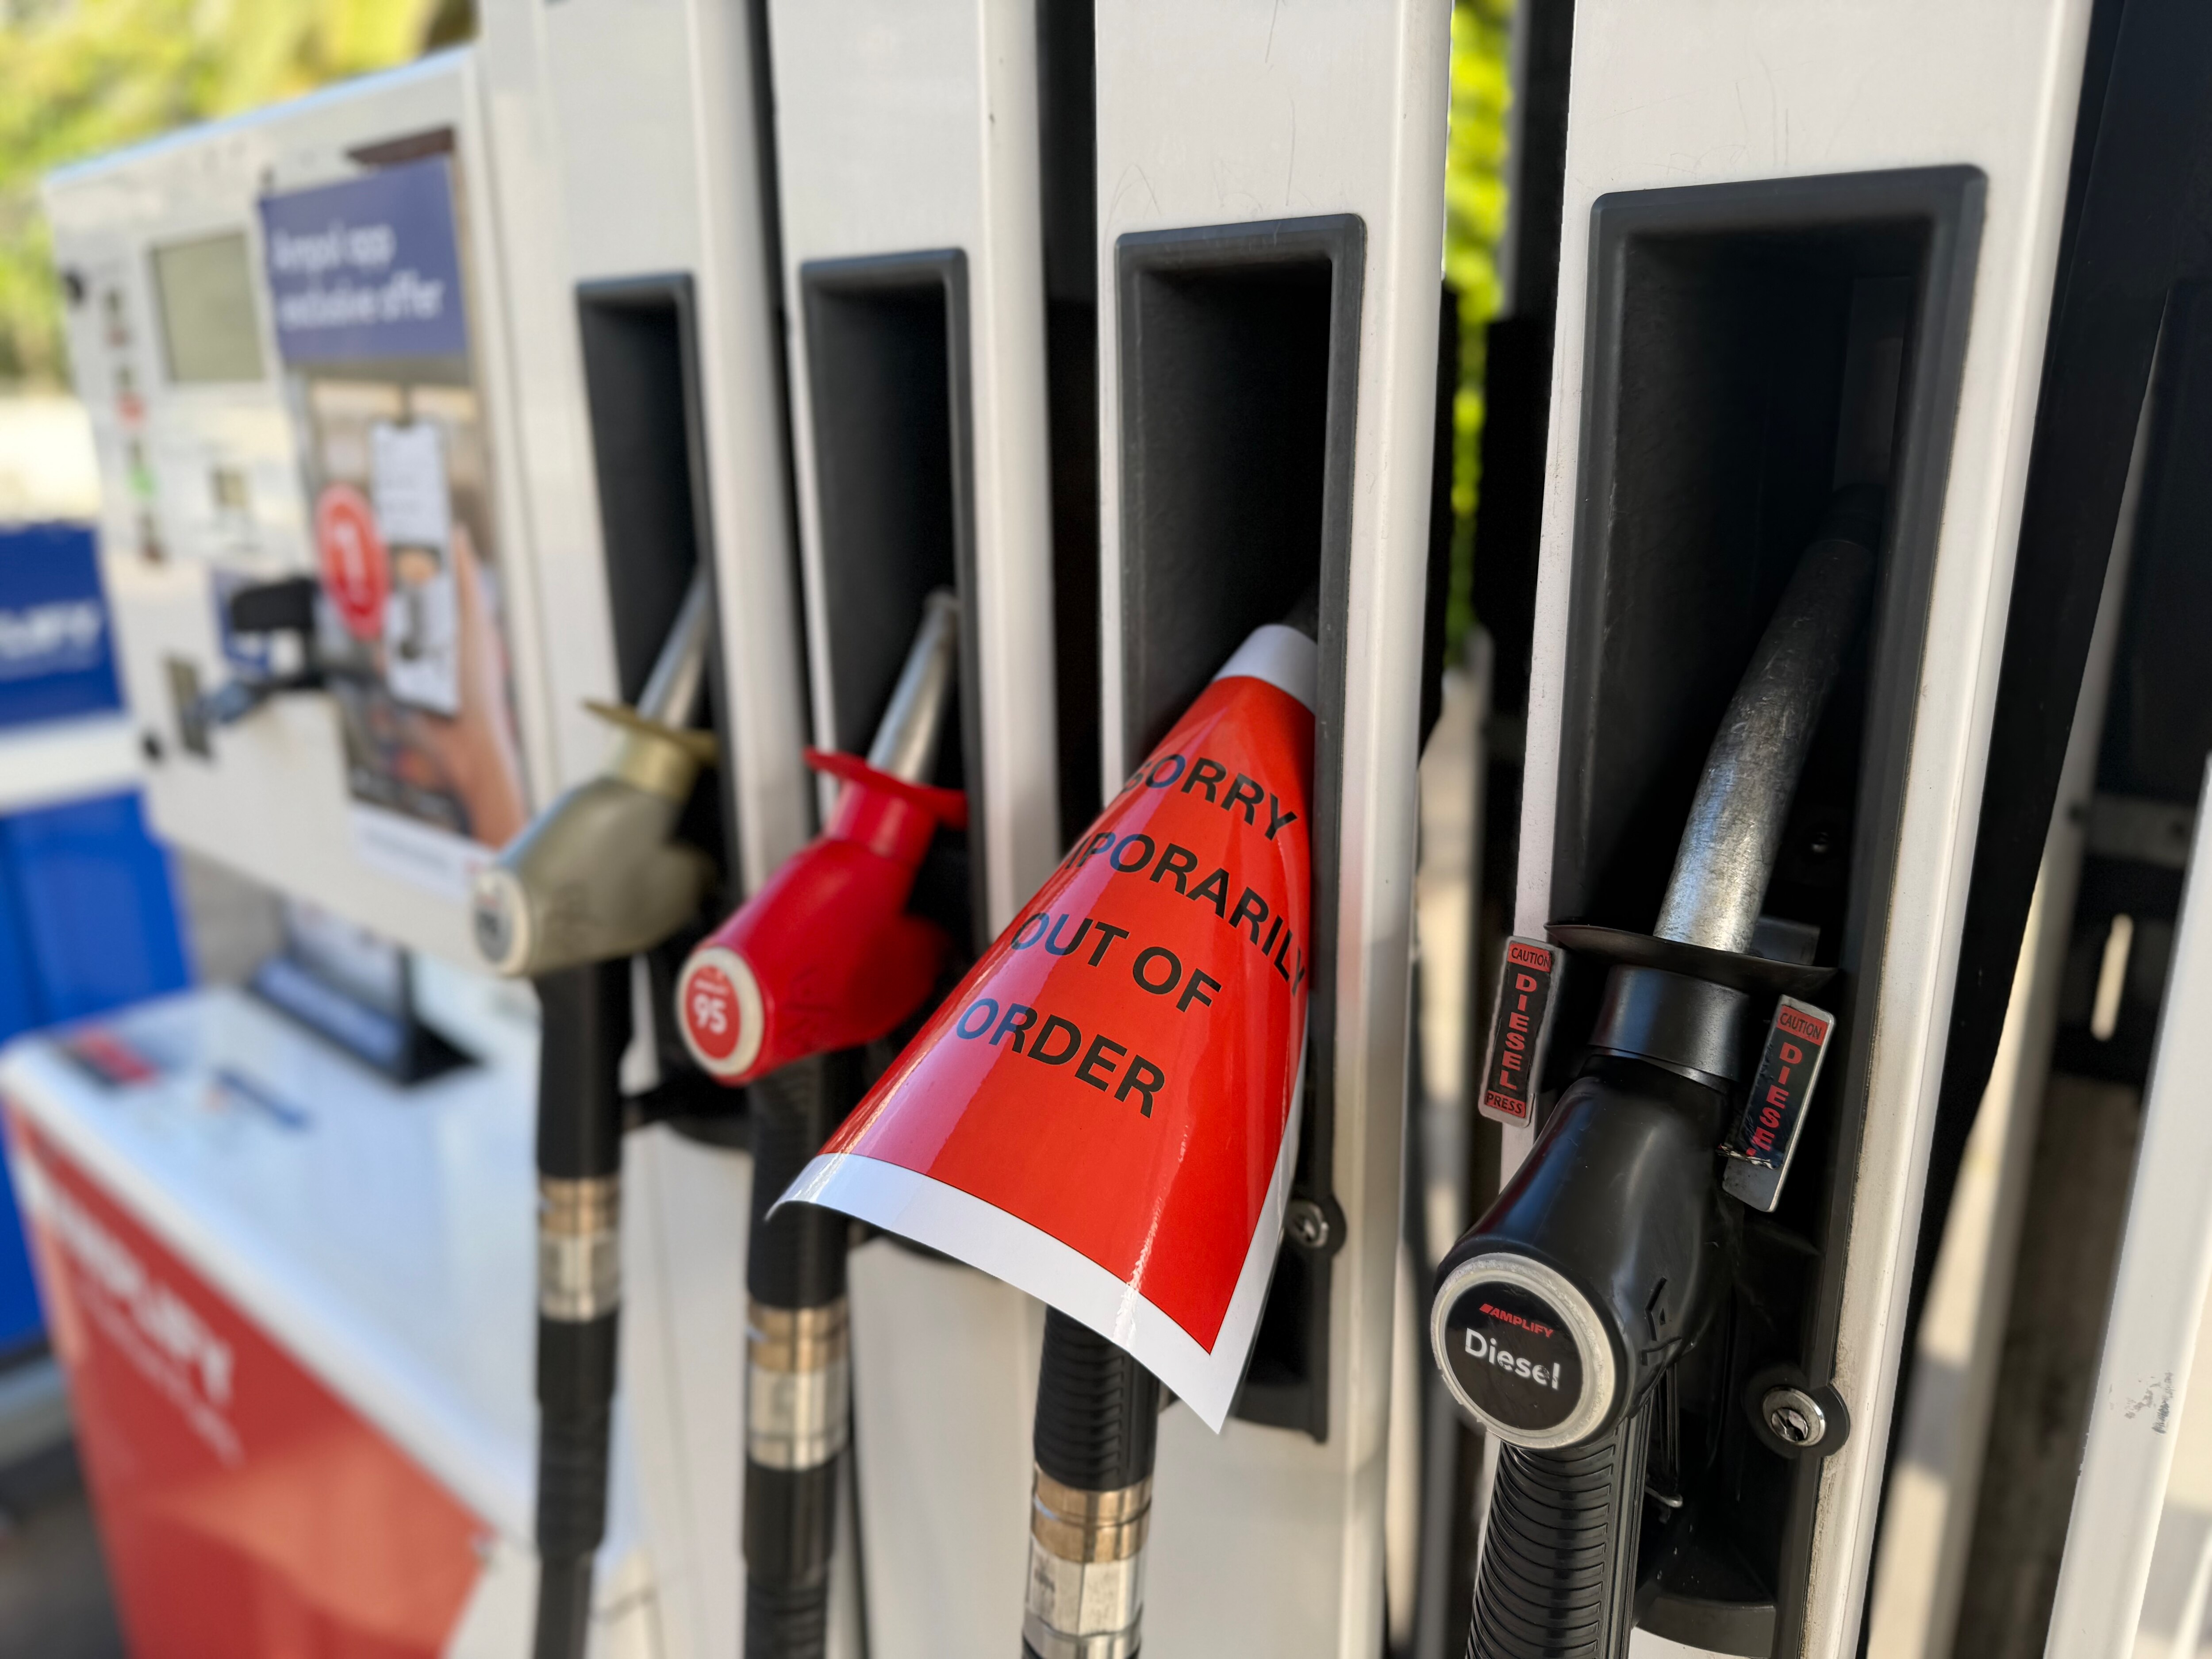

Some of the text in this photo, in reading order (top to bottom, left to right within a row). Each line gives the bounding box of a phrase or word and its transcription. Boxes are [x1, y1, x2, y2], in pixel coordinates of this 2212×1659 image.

[1064, 832, 1306, 997] PORARILY
[1010, 912, 1222, 1013] OUT OF
[1511, 948, 1550, 968] CAUTION
[693, 994, 727, 1034] 95
[1499, 973, 1537, 1090] DIESEL
[1780, 1012, 1822, 1040] CAUTION
[956, 998, 1165, 1118] ORDER
[1486, 1091, 1522, 1114] PRESS
[1746, 1042, 1803, 1157] DIESE
[1490, 1308, 1554, 1338] AMPLIFY
[1465, 1328, 1560, 1390] Diesel
